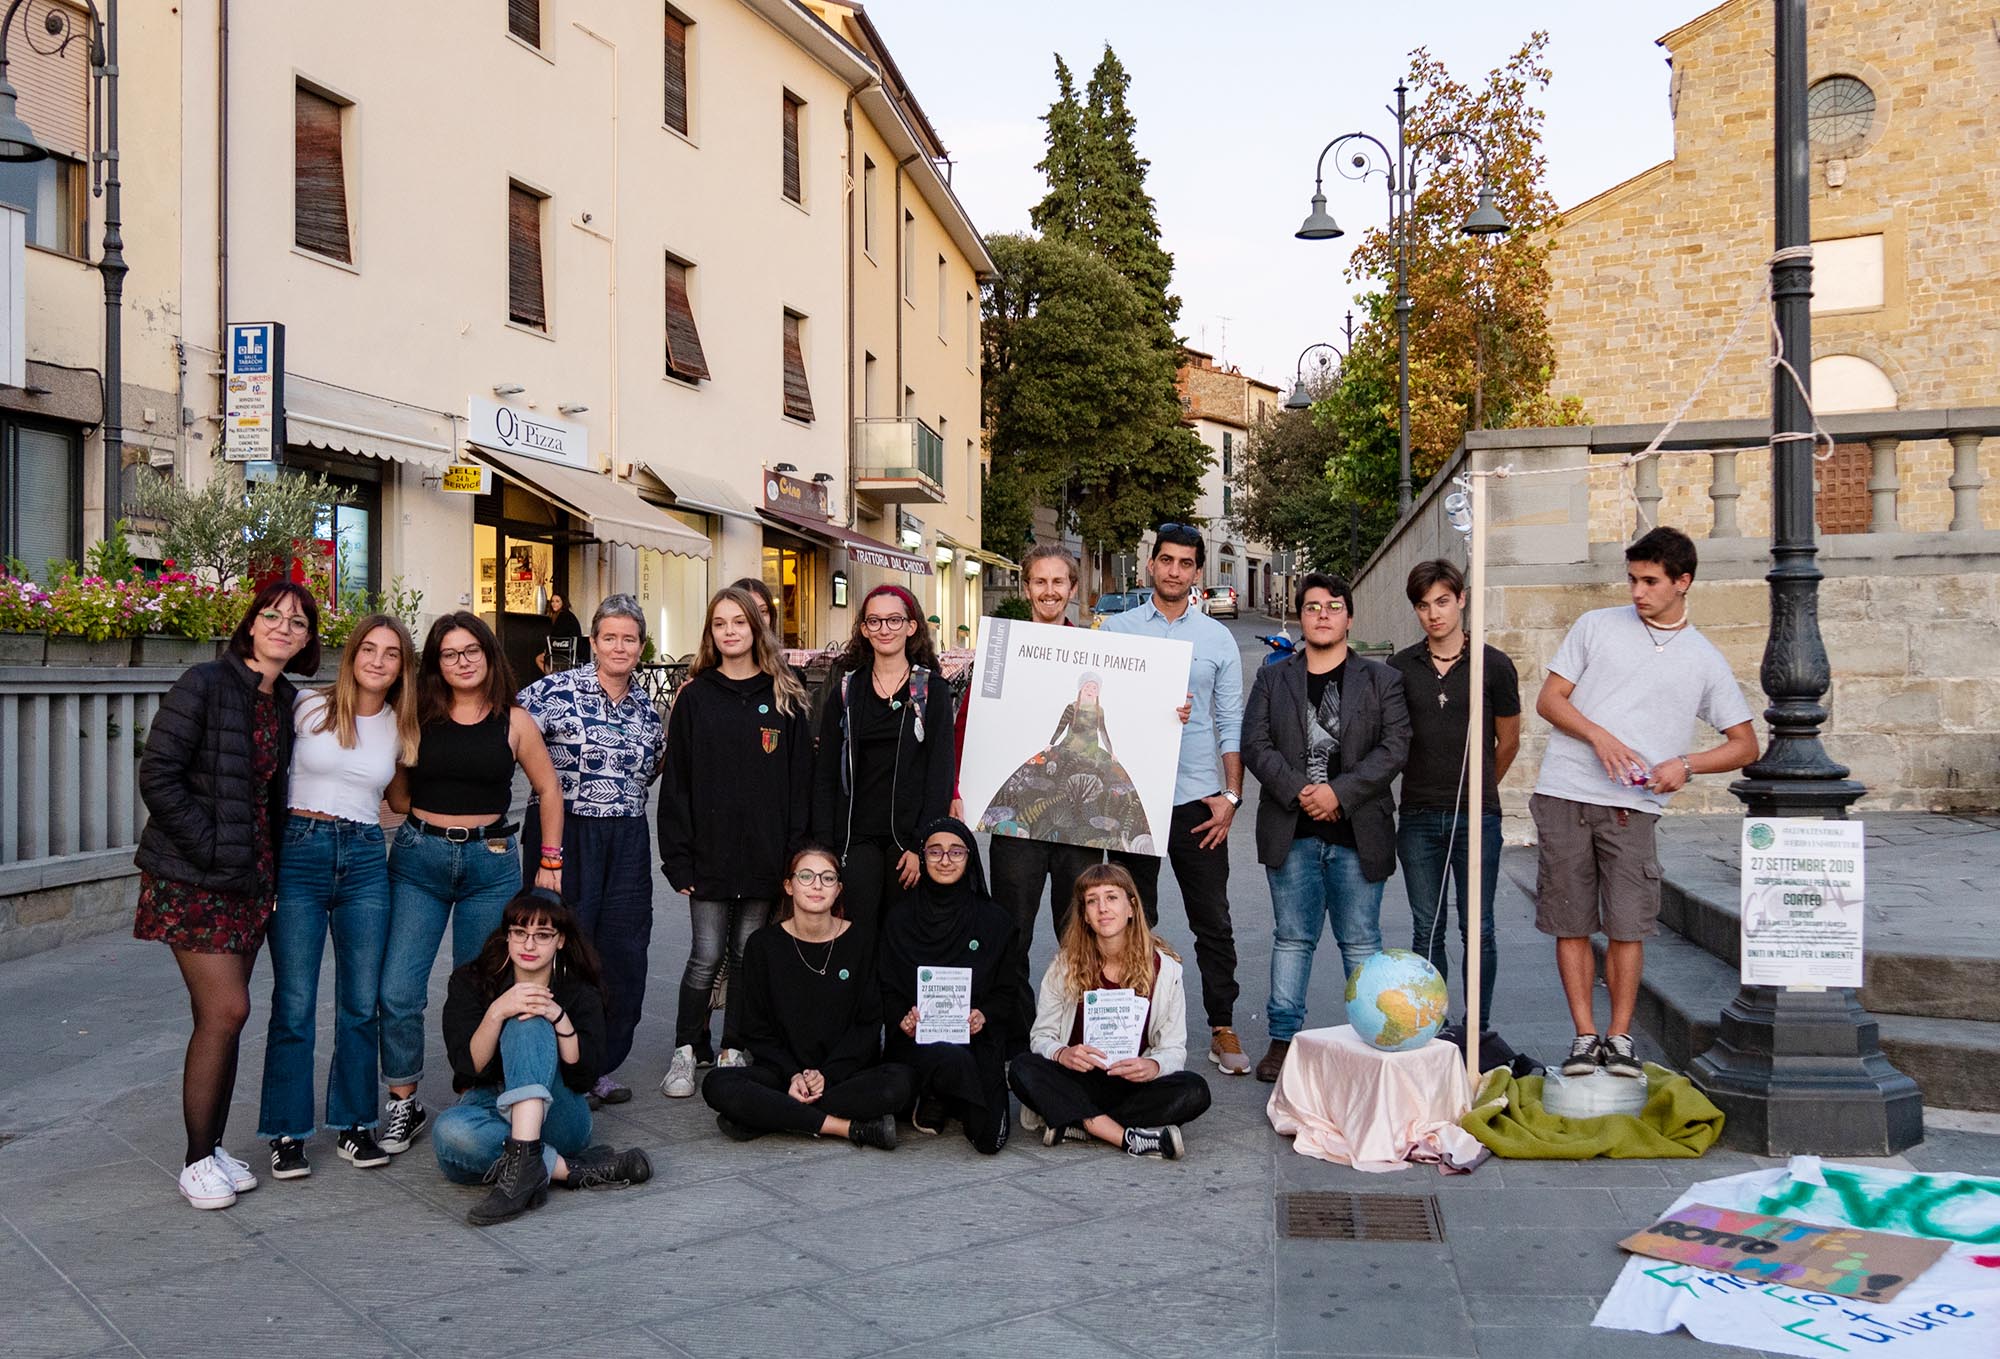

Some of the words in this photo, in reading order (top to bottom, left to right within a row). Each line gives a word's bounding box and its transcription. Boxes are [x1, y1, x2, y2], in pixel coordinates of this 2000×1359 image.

[241, 328, 261, 354] T
[496, 407, 519, 447] Qì
[525, 424, 563, 451] Pizza
[445, 479, 480, 489] SERVICE
[856, 550, 890, 568] TRATTORIA
[890, 557, 903, 570] DAL
[1018, 644, 1052, 661] ANCHE
[1056, 648, 1069, 663] TU
[1072, 650, 1088, 665] SEI
[1092, 652, 1100, 667] IL
[1104, 655, 1146, 673] PIANETA
[1751, 857, 1764, 870] 27
[1766, 857, 1826, 872] SETTEMBRE
[1829, 859, 1854, 873] 2019
[1783, 892, 1822, 906] CORTEO
[1747, 949, 1766, 958] UNITI
[1776, 949, 1799, 958] PIAZZA
[1801, 950, 1813, 959] PER
[1647, 1220, 1778, 1254] ROTTO
[1780, 1302, 1974, 1352] Future
